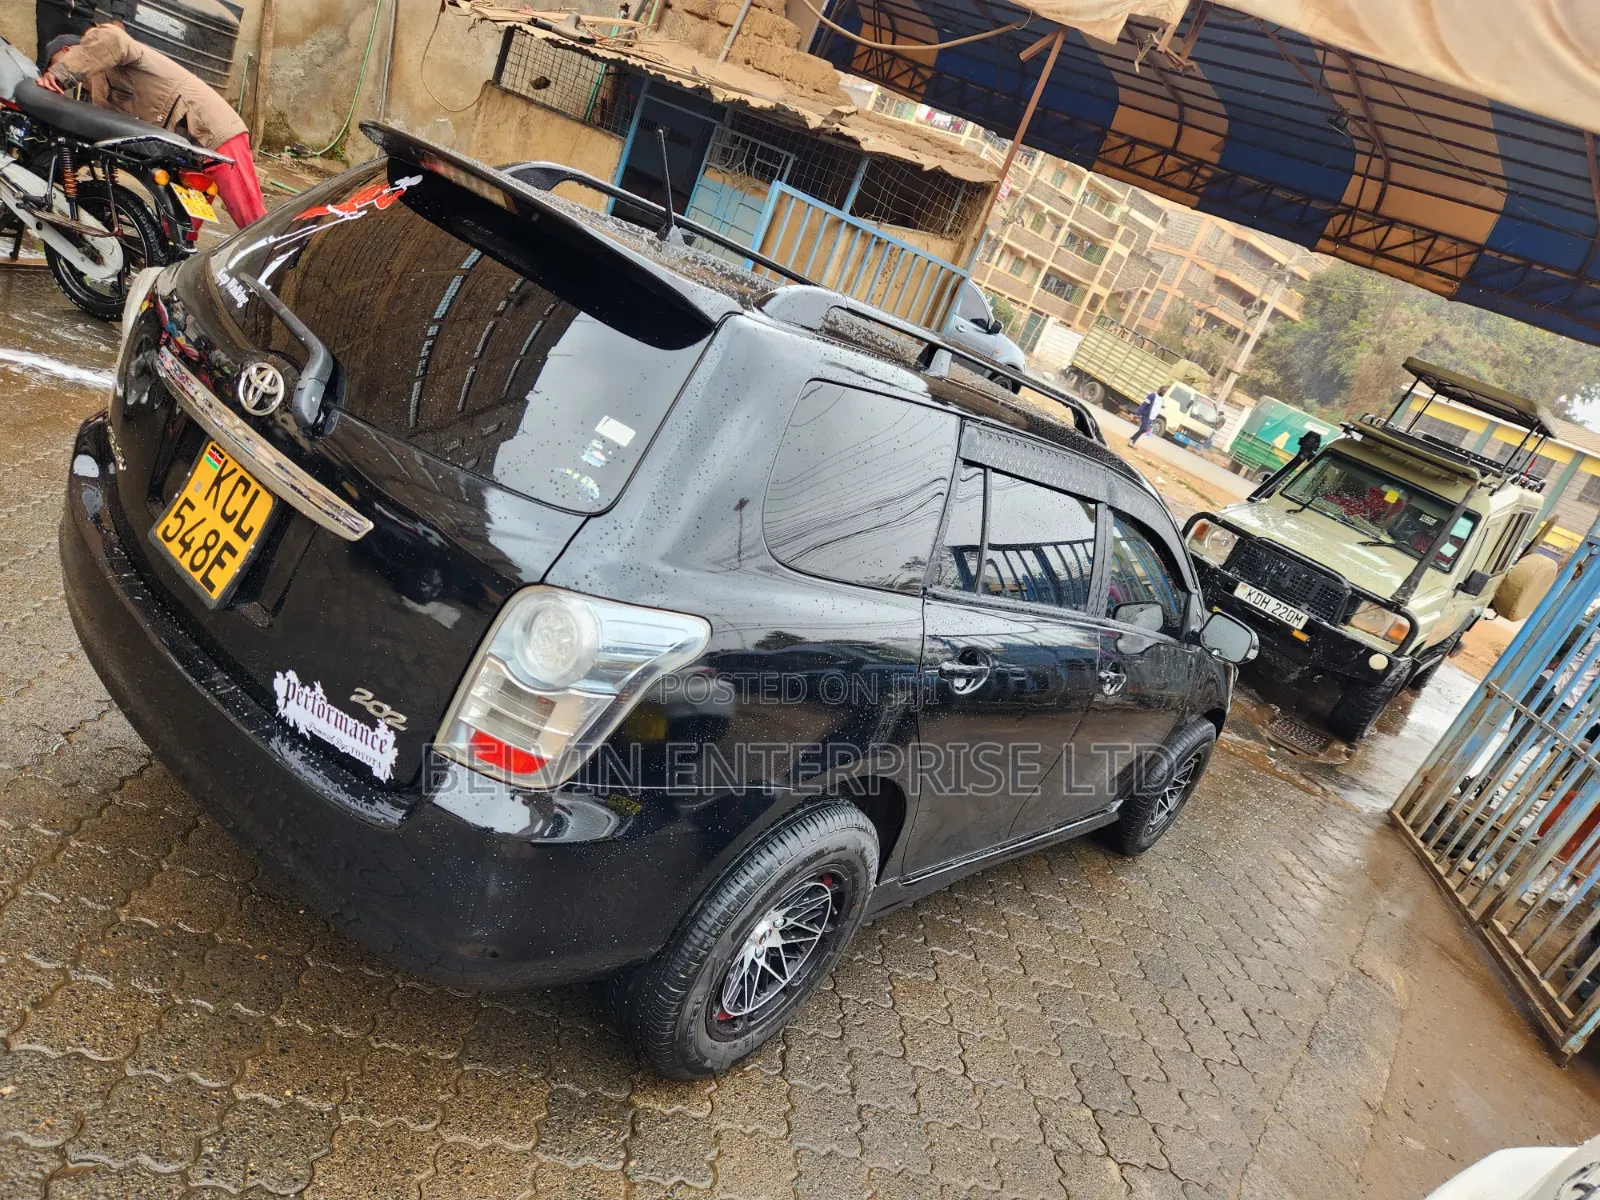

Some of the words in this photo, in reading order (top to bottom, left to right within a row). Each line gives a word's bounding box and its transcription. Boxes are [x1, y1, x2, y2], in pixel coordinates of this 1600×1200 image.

[225, 276, 250, 308] Walking
[204, 459, 261, 542] KCL
[161, 497, 239, 593] 548E
[1244, 588, 1272, 609] KDH
[1271, 602, 1305, 627] 220M
[349, 687, 408, 731] 202
[350, 745, 382, 769] TOYOTA
